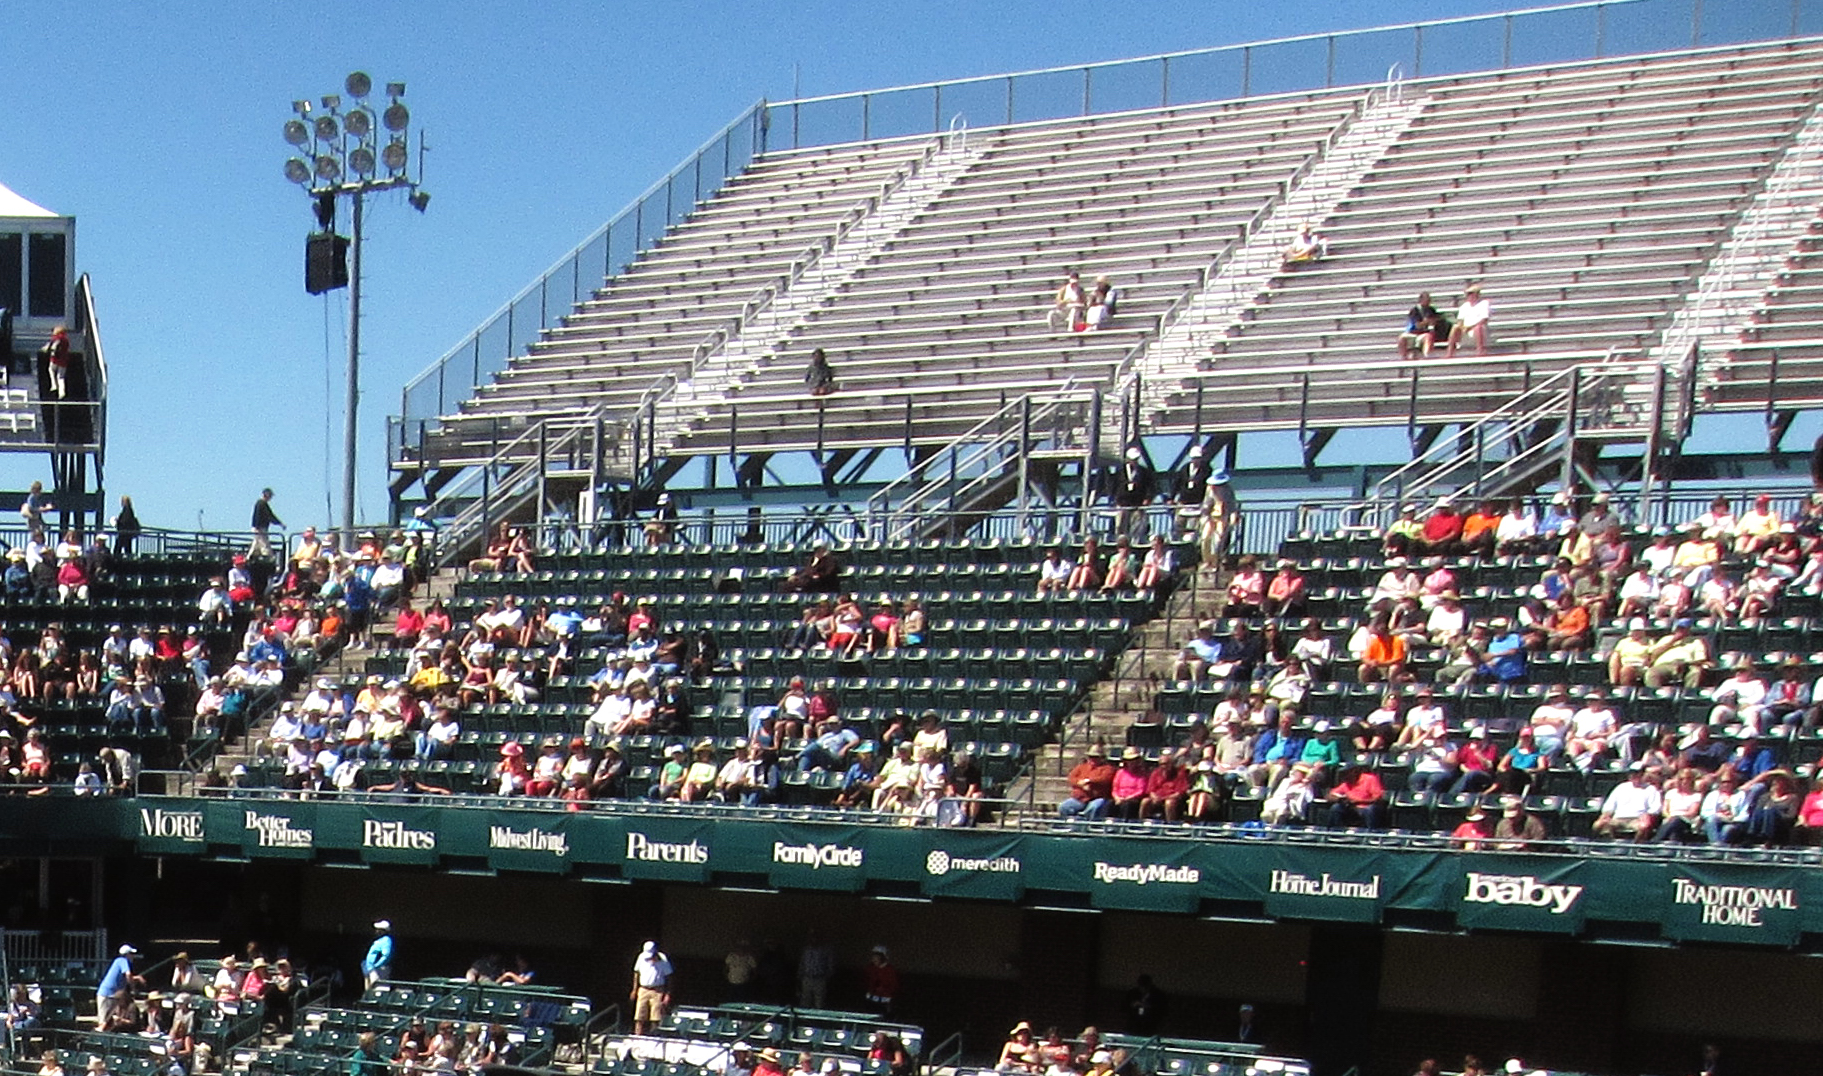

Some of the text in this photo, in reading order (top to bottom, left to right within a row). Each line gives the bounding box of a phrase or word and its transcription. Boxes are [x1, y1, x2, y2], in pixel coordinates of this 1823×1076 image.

[140, 808, 204, 838] MORE
[245, 811, 291, 829] Better
[259, 828, 313, 847] Homes
[626, 833, 709, 863] Parents
[951, 856, 1020, 873] meredith
[1094, 862, 1200, 884] ReadyMade
[1464, 873, 1582, 914] baby
[1672, 878, 1797, 911] TRADITIONAL
[1702, 905, 1763, 926] HOME
